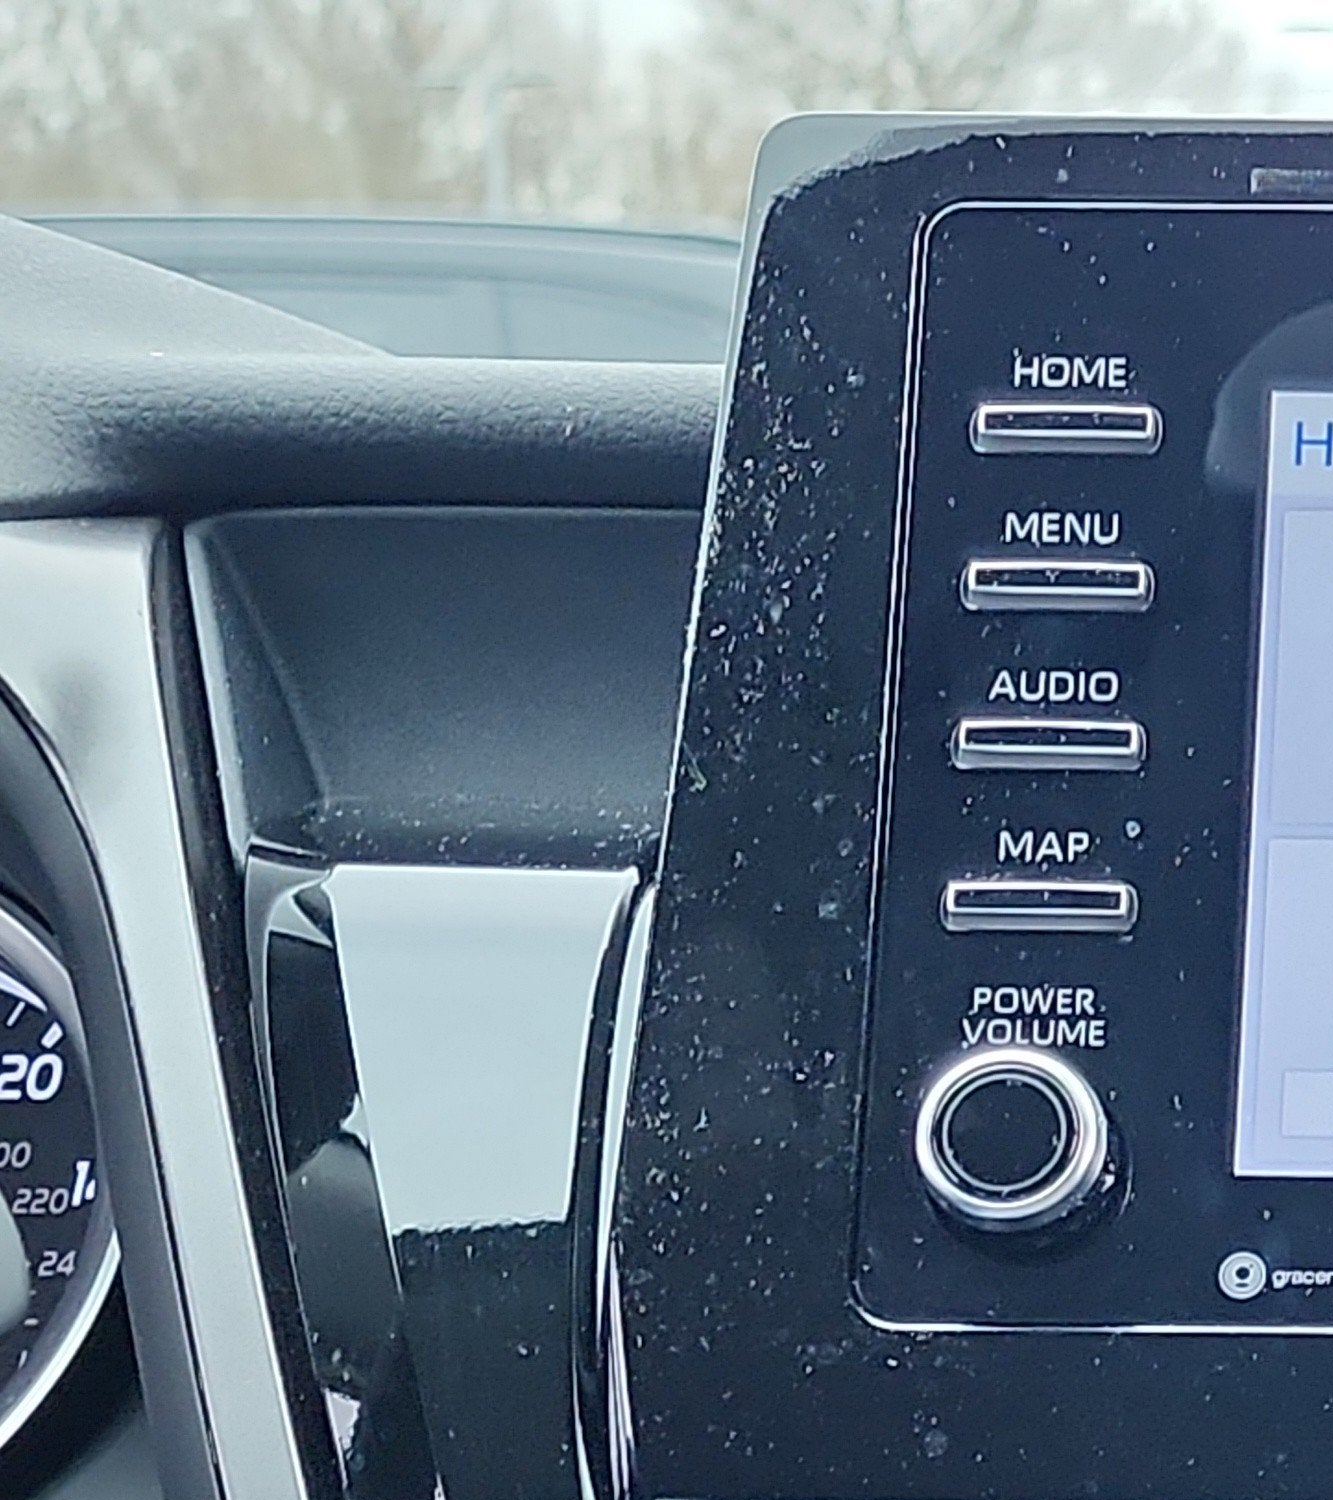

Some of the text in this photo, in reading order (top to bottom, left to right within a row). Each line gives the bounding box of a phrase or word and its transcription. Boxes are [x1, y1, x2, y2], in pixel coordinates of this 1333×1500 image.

[1013, 356, 1127, 387] HOME
[1003, 512, 1120, 544] MENU
[988, 670, 1119, 702] AUDIO
[998, 831, 1090, 862] MAP
[972, 987, 1096, 1016] POWER
[962, 1018, 1107, 1047] VOLUME
[11, 1187, 70, 1215] 220
